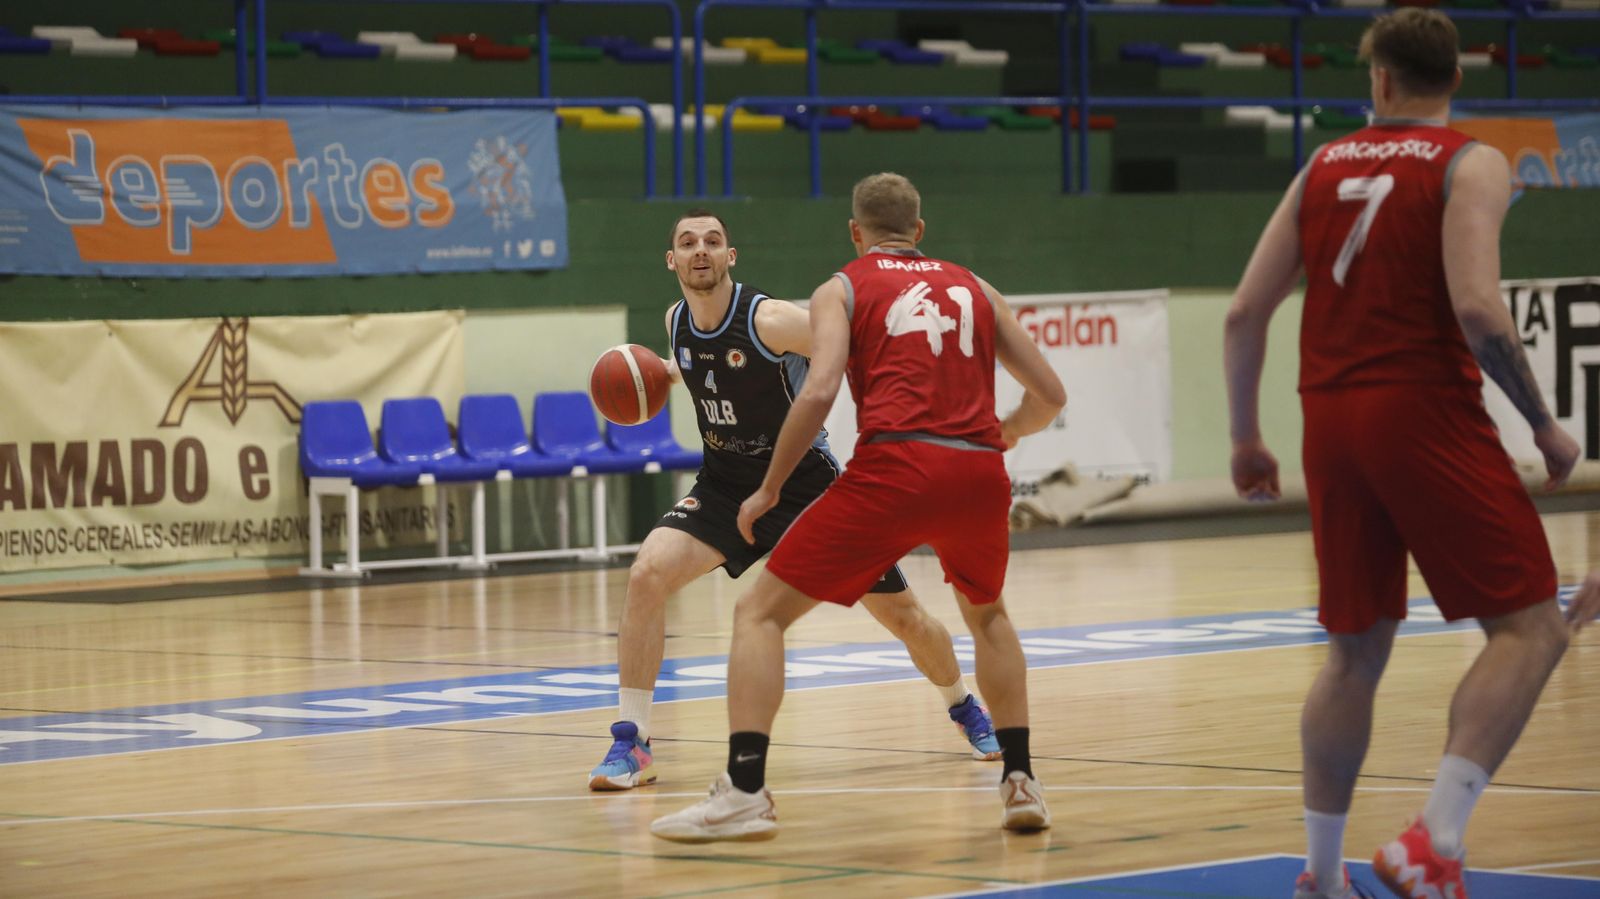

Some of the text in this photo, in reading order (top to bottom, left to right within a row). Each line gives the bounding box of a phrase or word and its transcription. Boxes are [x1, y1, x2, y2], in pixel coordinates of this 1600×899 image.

[40, 128, 455, 256] deportes
[1332, 173, 1394, 288] 7
[884, 280, 974, 358] 41
[1016, 304, 1119, 348] Galán
[698, 353, 716, 361] vive
[704, 369, 718, 394] 4
[700, 398, 738, 426] ULB
[238, 444, 271, 502] e
